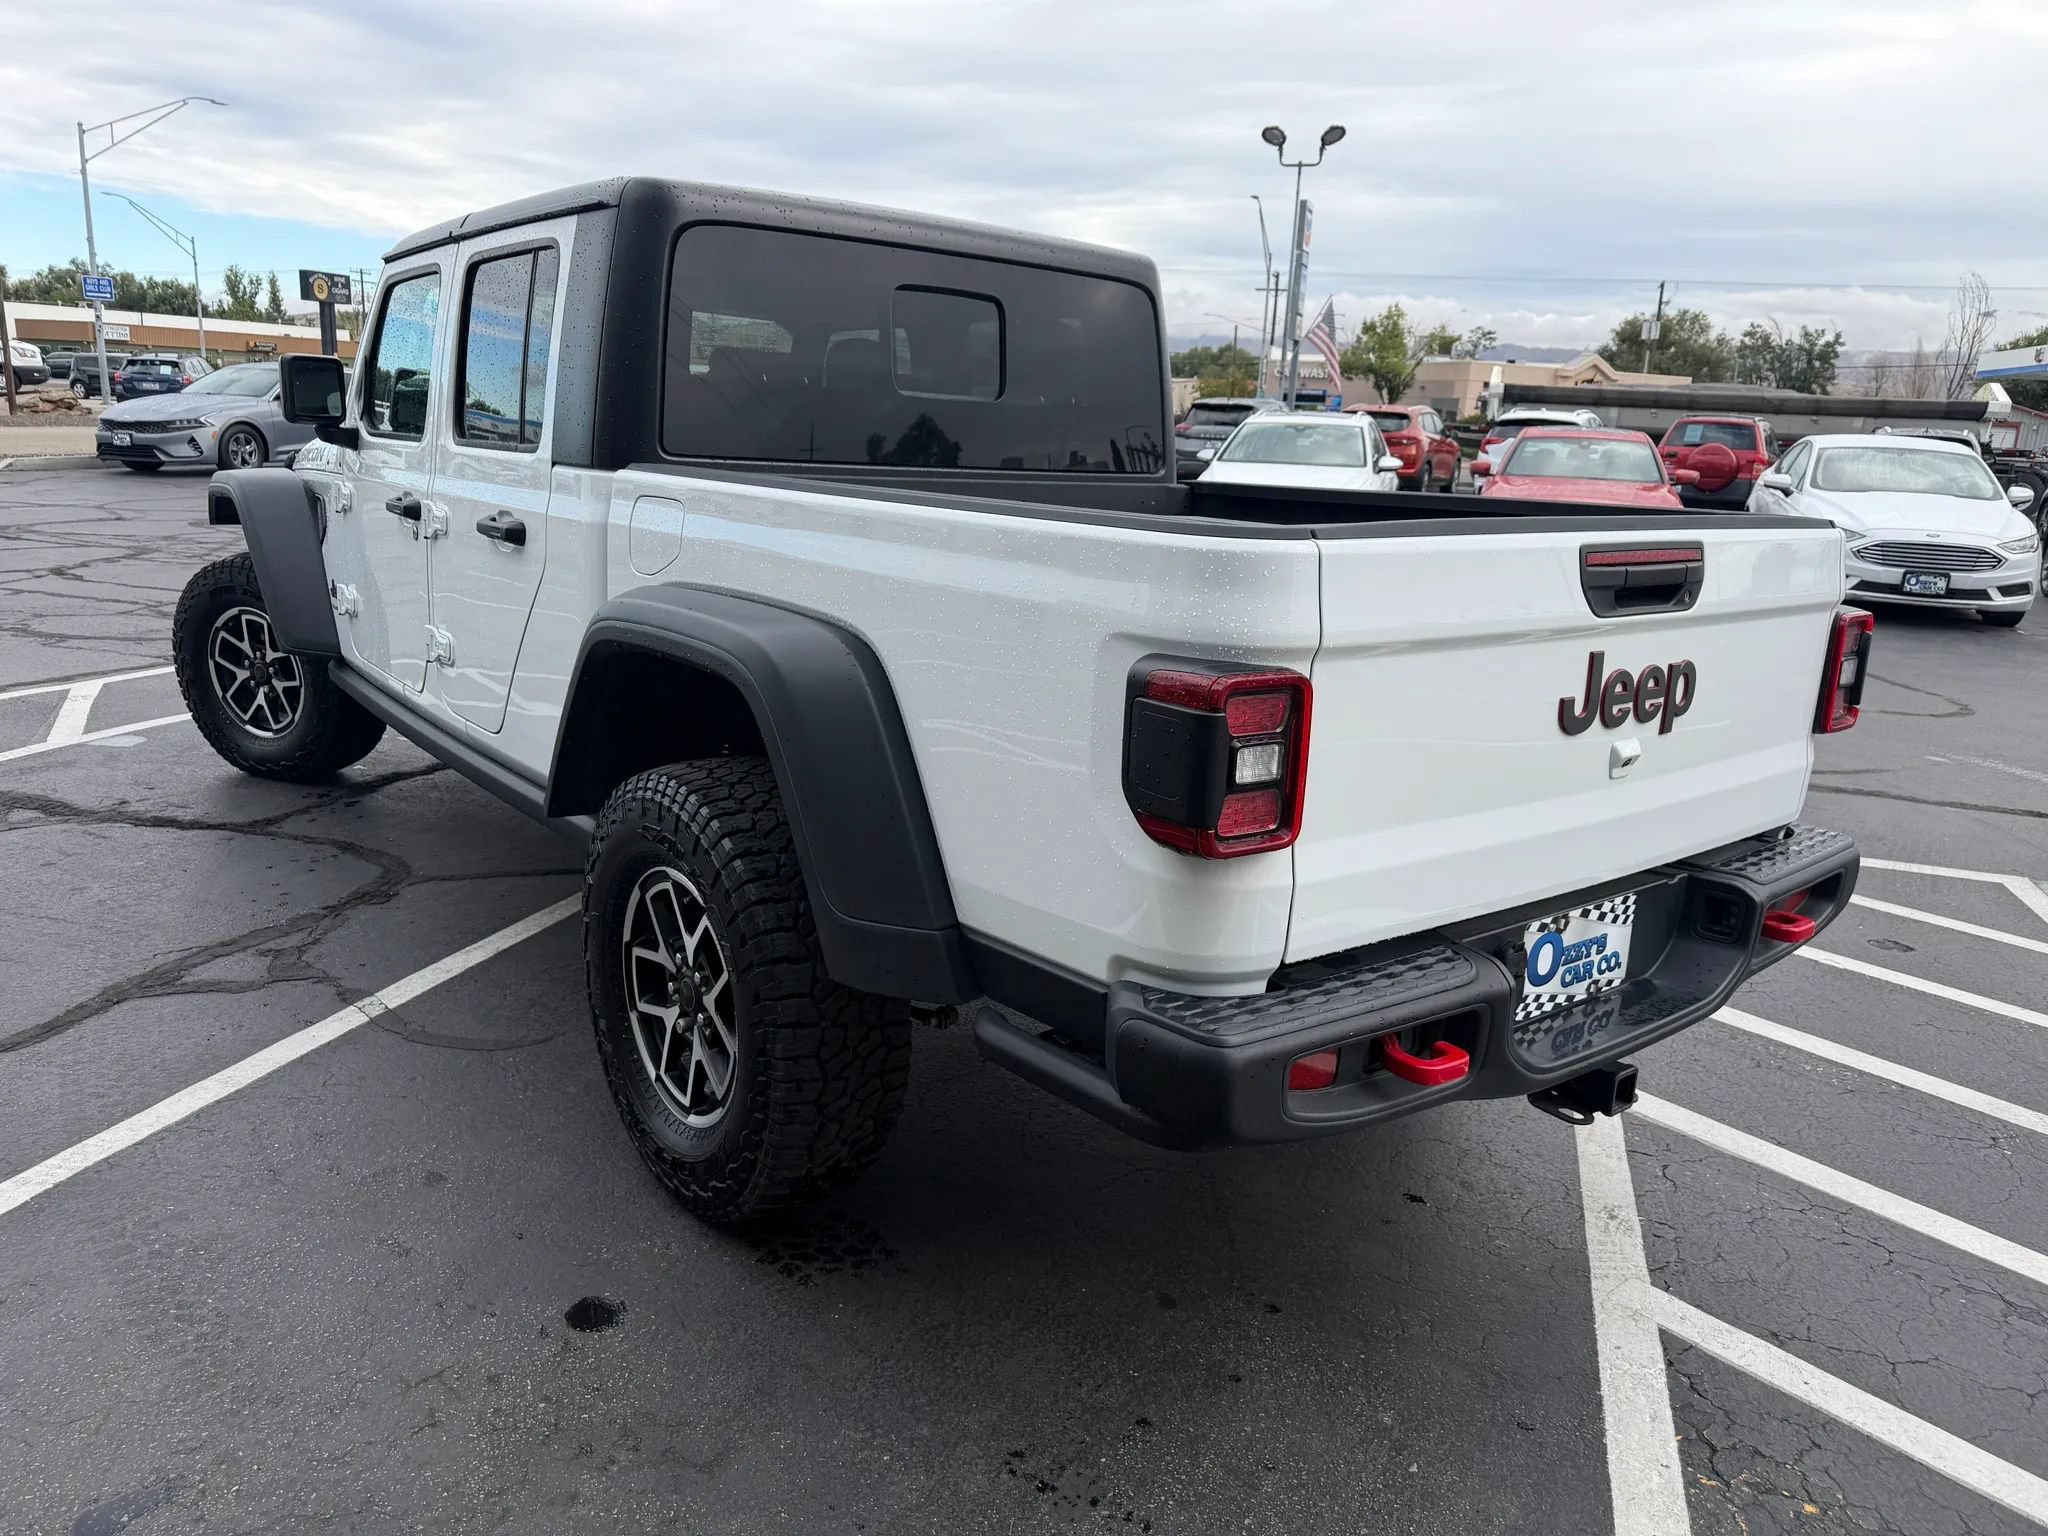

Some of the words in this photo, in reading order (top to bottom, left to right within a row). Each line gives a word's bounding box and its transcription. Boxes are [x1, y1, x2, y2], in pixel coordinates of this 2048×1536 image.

[317, 283, 324, 294] S
[1557, 650, 1697, 737] Jeep
[1527, 931, 1609, 988] OZZY'S
[1560, 959, 1595, 989] CAR
[1596, 950, 1622, 976] CO.
